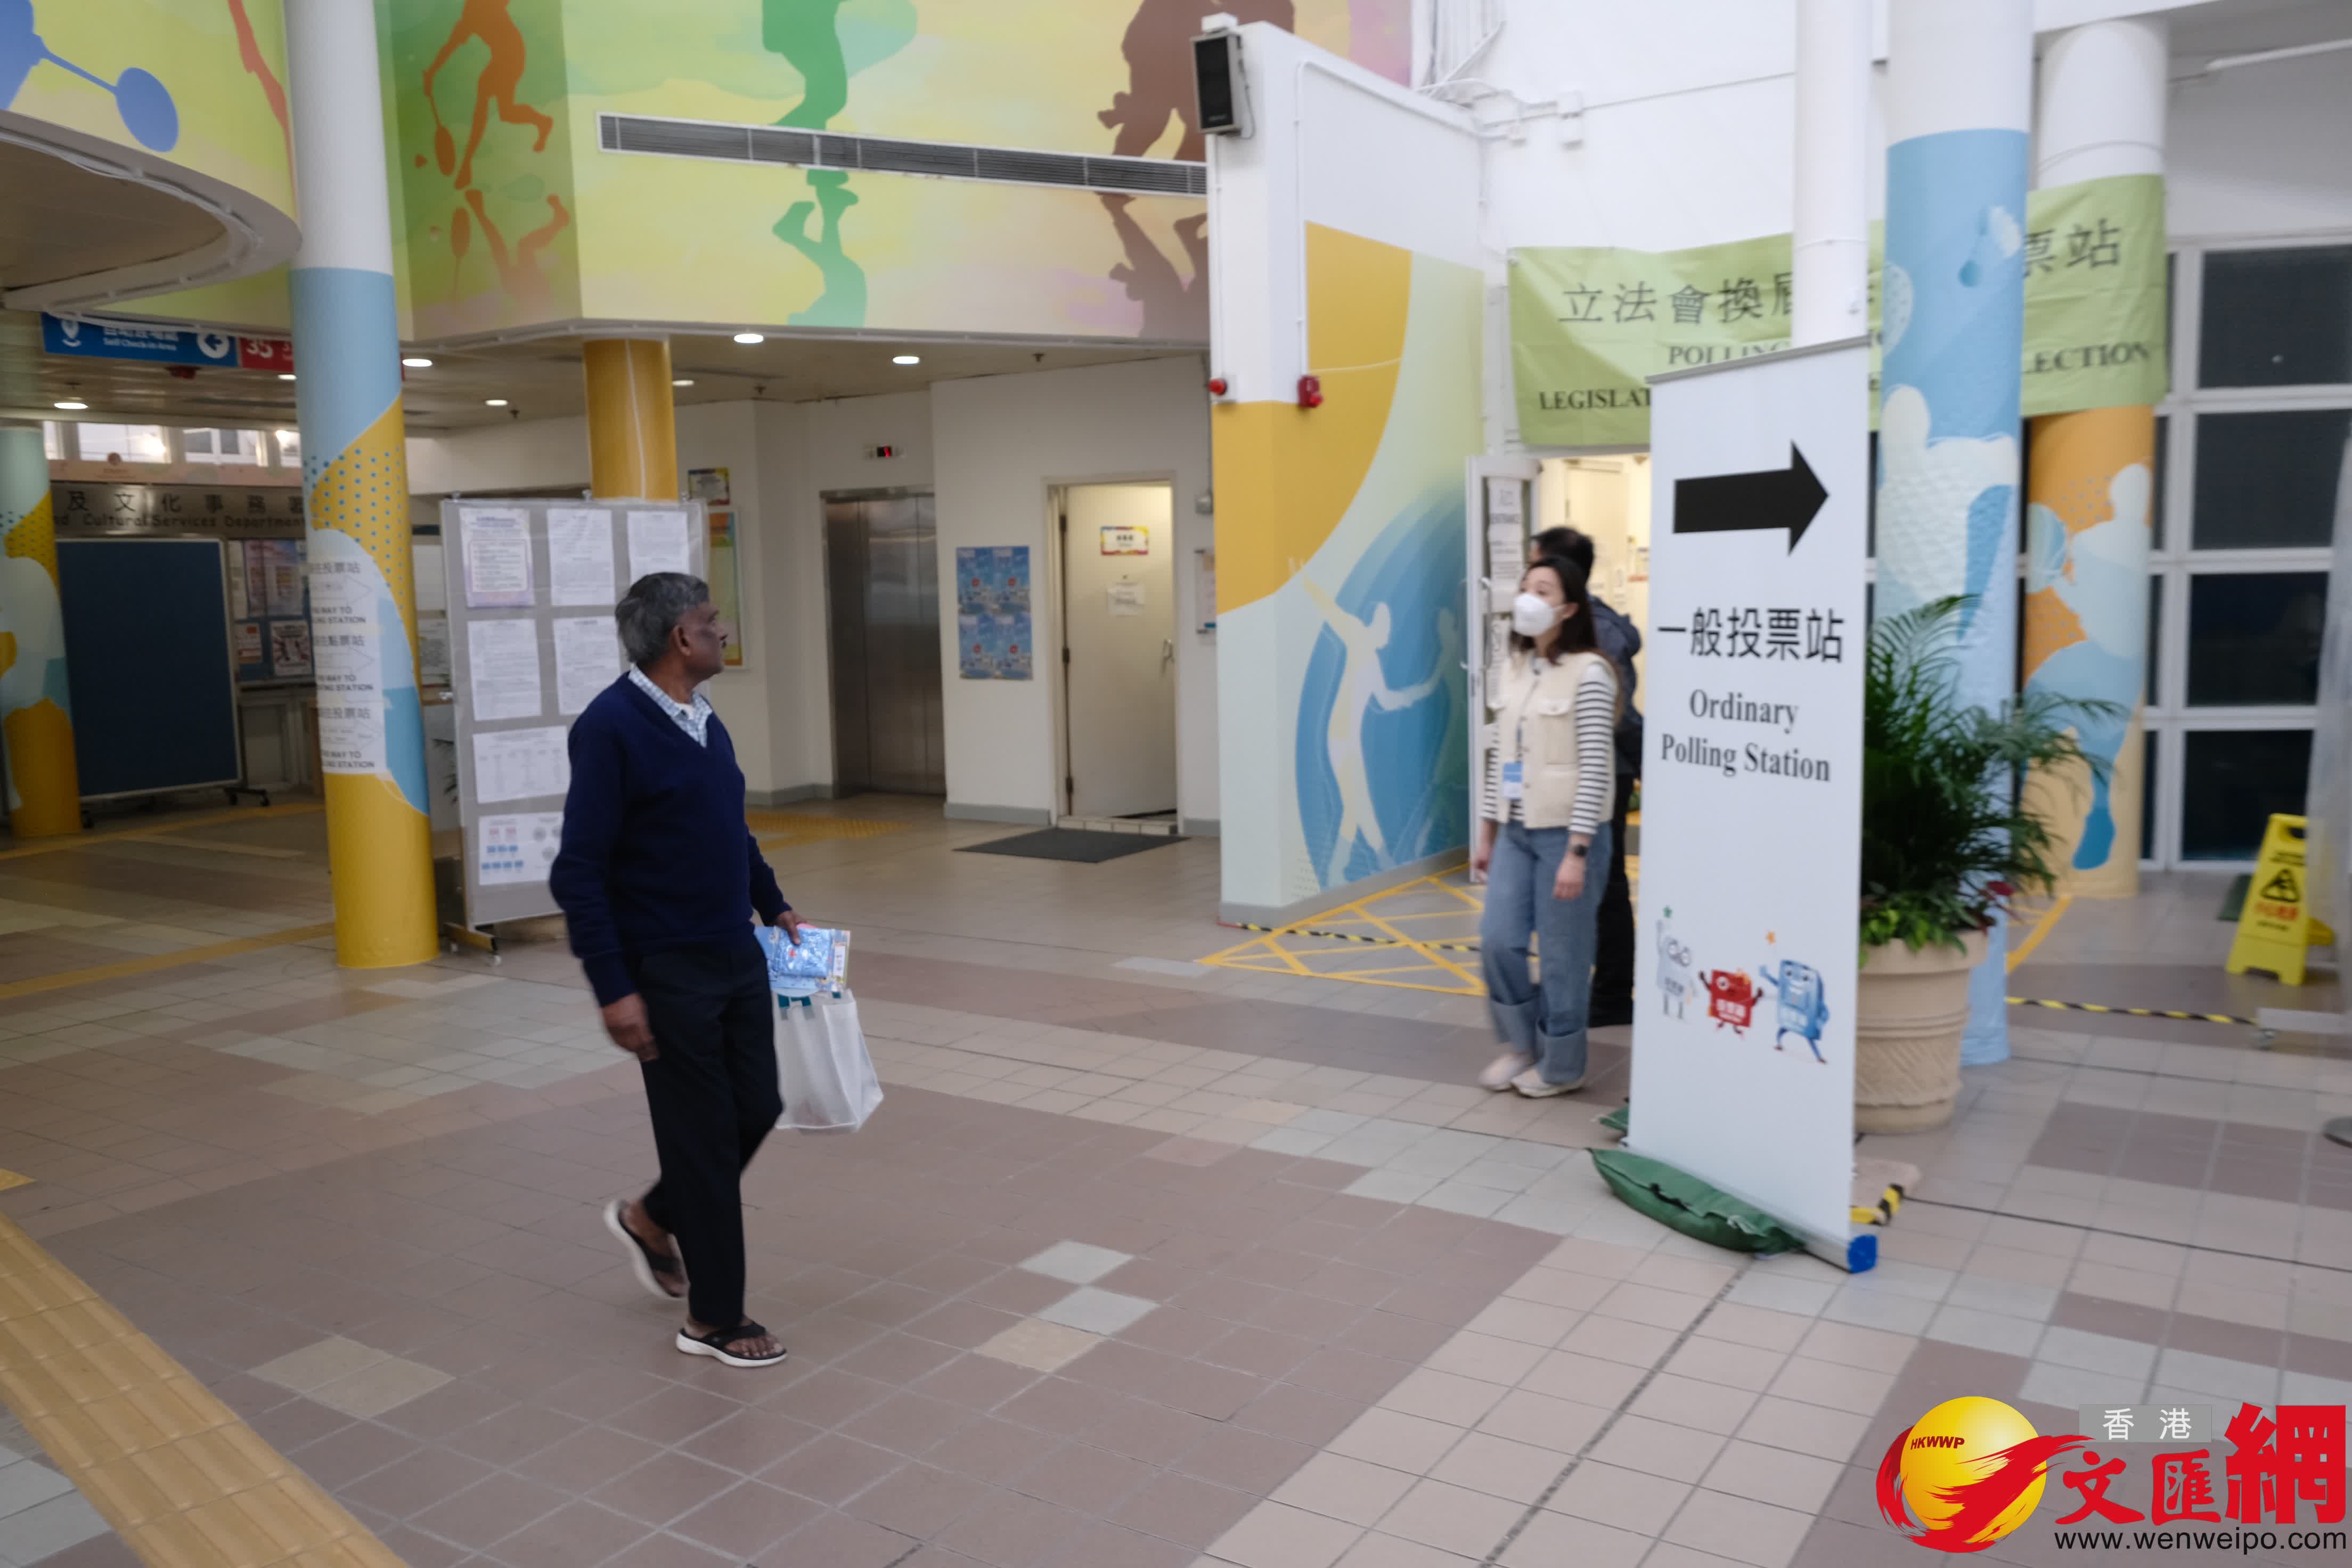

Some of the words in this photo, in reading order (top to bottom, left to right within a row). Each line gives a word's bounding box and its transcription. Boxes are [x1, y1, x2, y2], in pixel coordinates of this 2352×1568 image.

[2022, 341, 2149, 374] ECTION
[152, 514, 216, 527] Services
[1657, 607, 1844, 663] 一般投票站
[1689, 689, 1799, 734] Ordinary
[1661, 733, 1737, 777] Polling
[1743, 742, 1831, 782] Station
